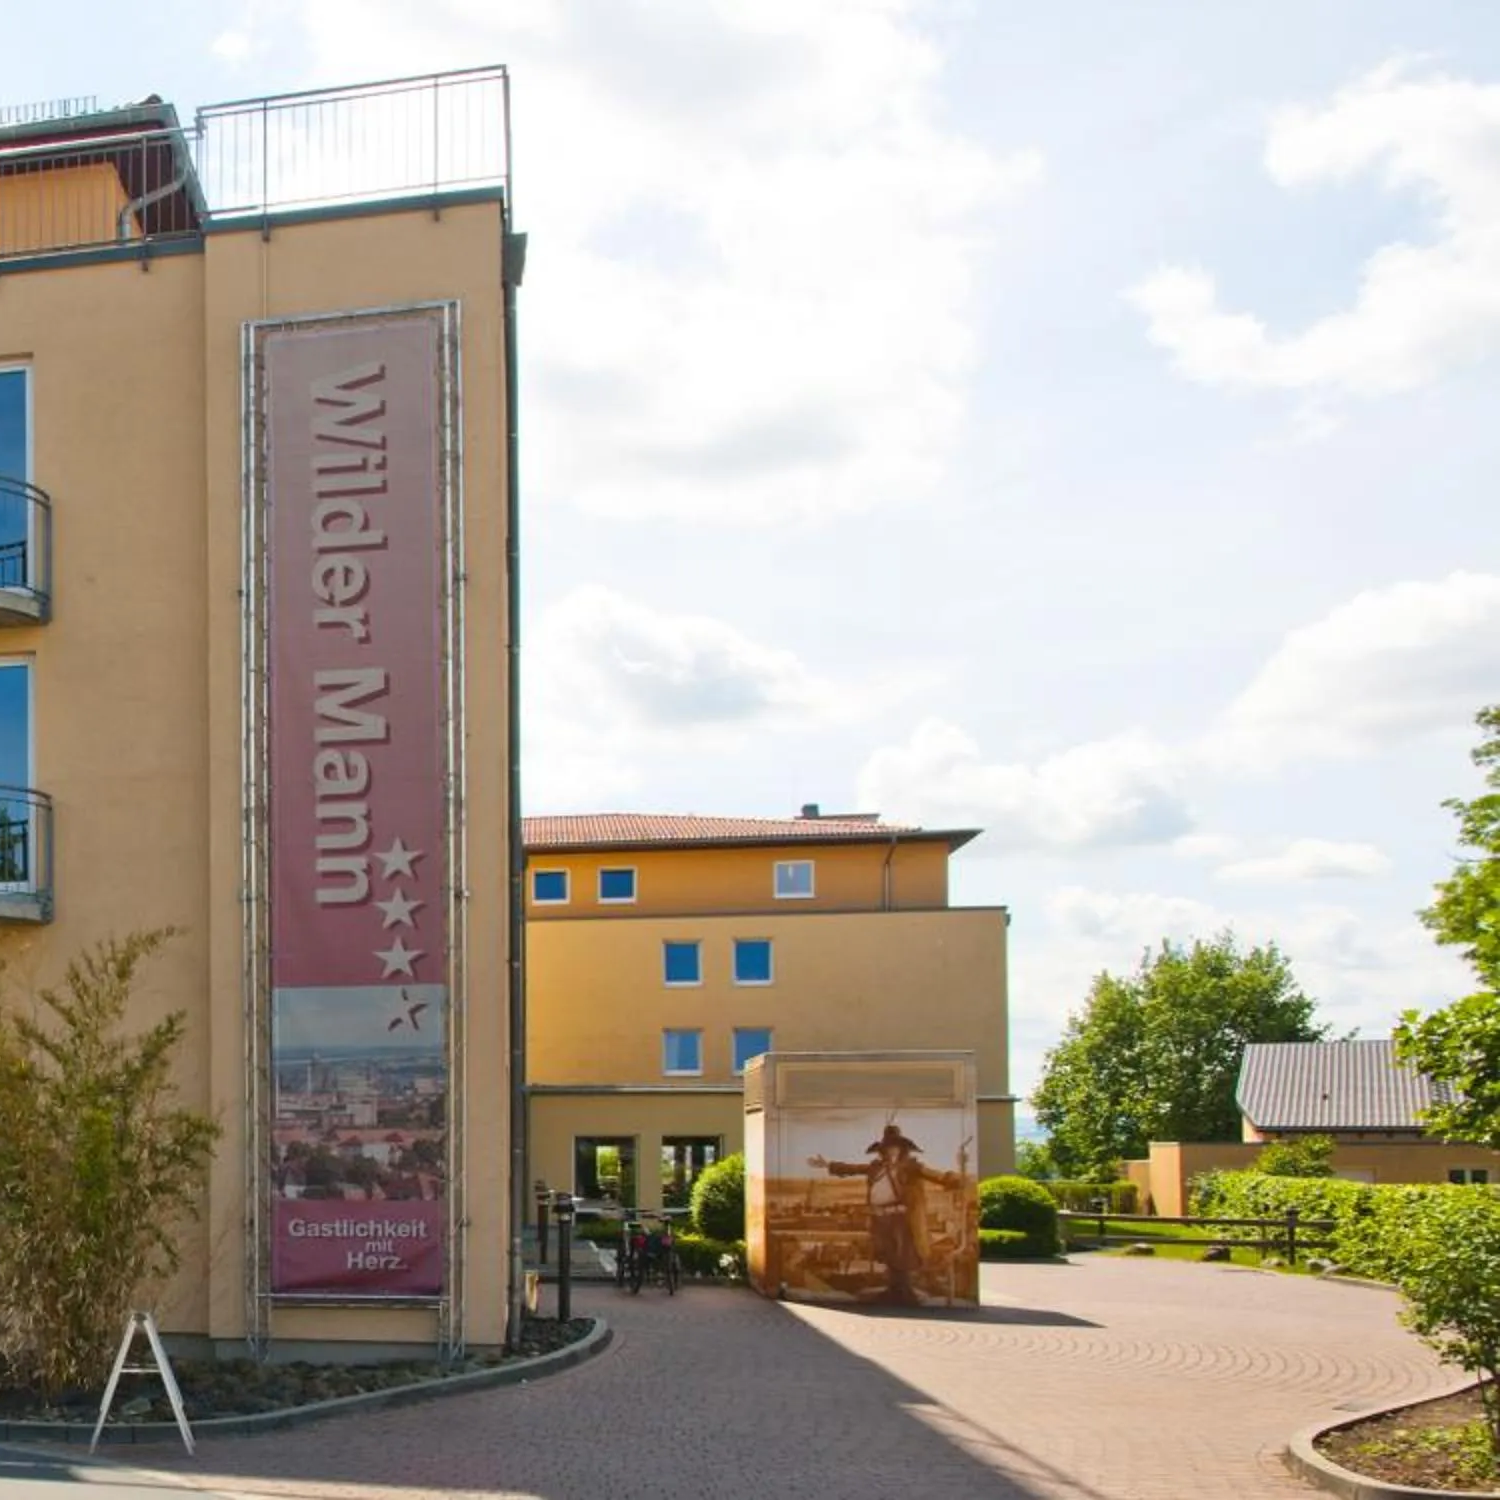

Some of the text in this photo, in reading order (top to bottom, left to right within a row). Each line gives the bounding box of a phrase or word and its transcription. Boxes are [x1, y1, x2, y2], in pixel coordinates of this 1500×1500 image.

[310, 362, 389, 905] Wilder Mann
[289, 1219, 427, 1238] Gastlichkeit
[365, 1240, 393, 1253] mit
[347, 1252, 408, 1270] Herz.
